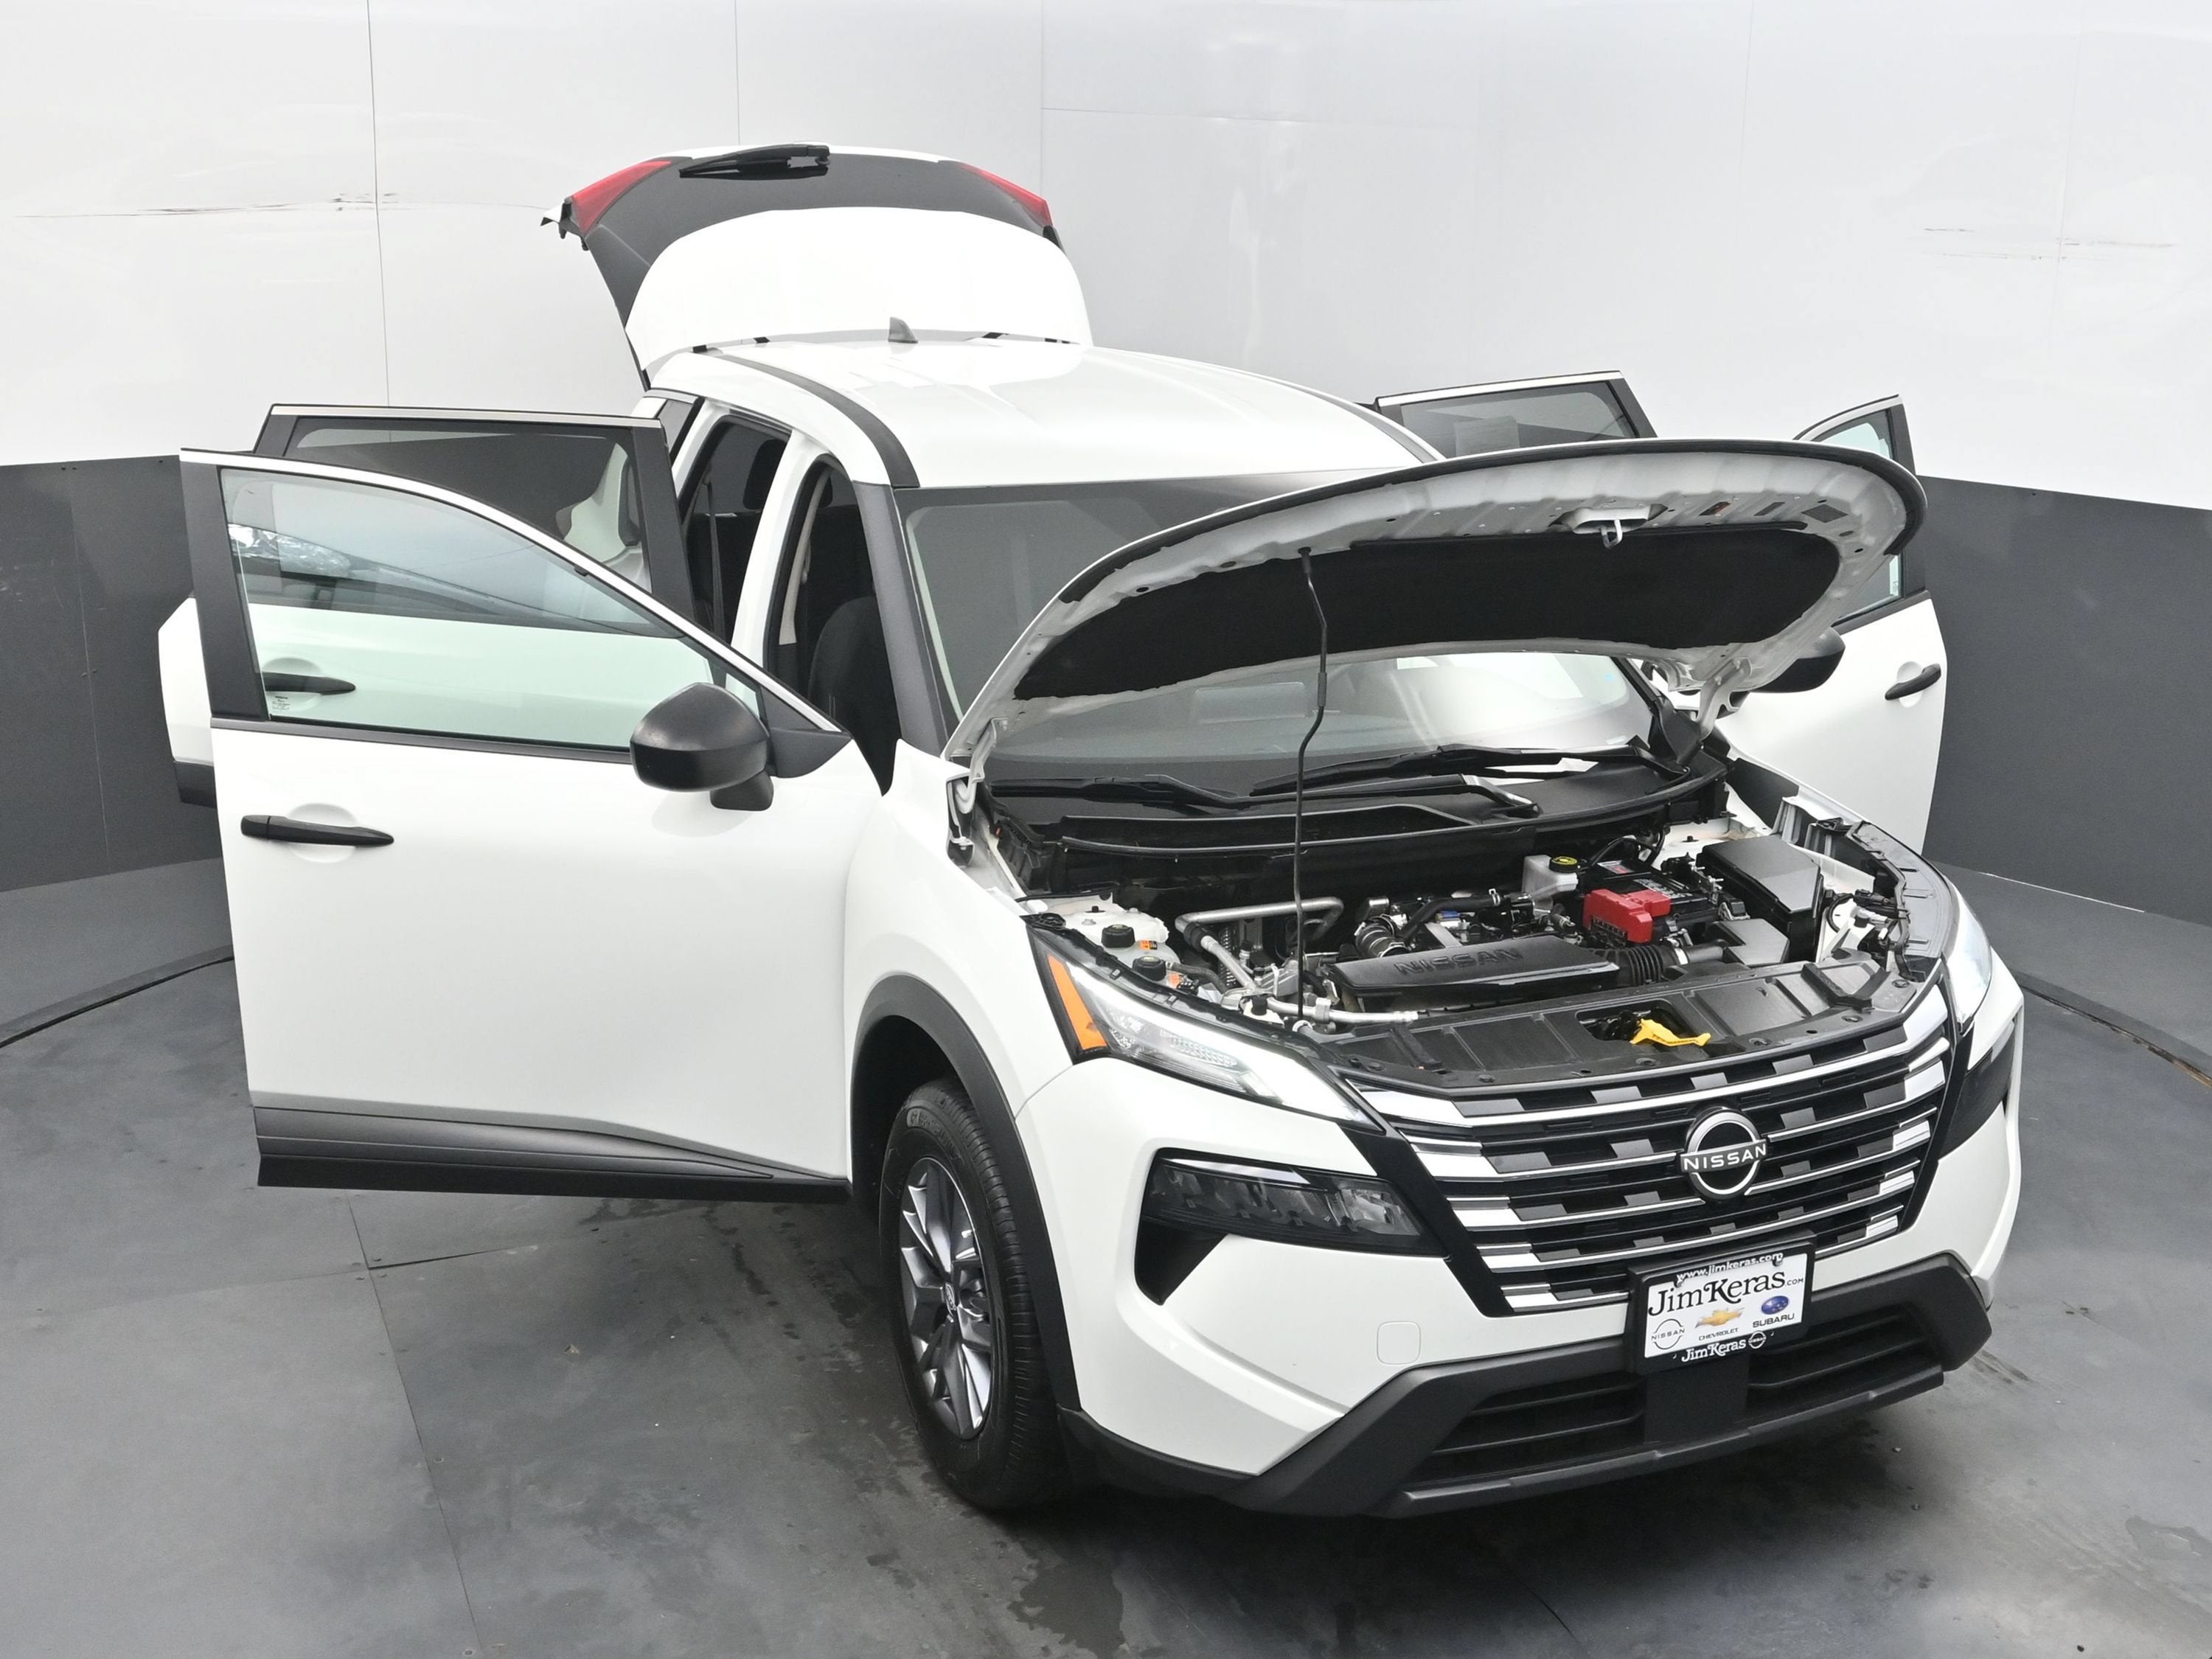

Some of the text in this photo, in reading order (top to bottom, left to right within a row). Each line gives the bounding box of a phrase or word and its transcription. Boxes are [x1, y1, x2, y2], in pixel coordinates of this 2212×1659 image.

[1394, 948, 1523, 975] NISSAN
[1683, 1143, 1767, 1171] NISSAN
[1676, 1253, 1784, 1283] www.jimkeras.com
[1753, 1312, 1795, 1328] SUBARU
[1652, 1328, 1686, 1340] NISSAN
[1698, 1327, 1739, 1341] CHEVROLET
